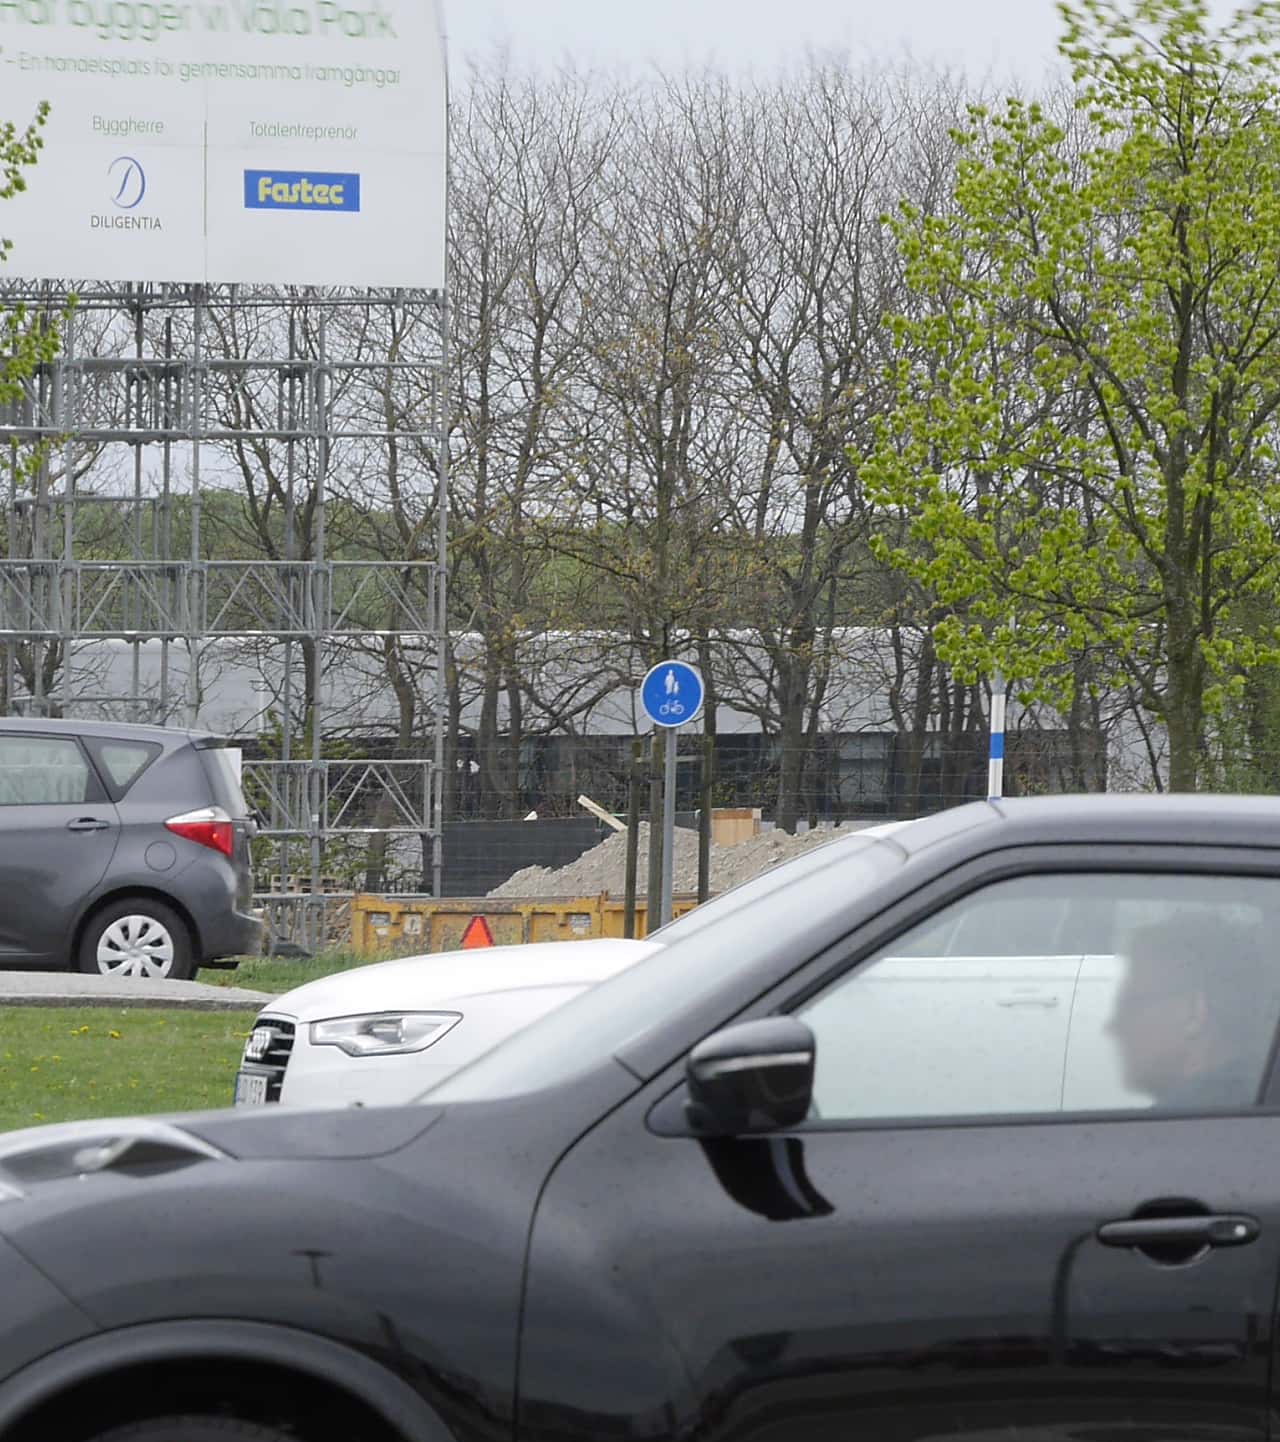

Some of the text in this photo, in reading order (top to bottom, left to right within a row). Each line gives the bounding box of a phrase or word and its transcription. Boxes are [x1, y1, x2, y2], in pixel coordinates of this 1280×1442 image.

[67, 0, 190, 42] bygger
[316, 0, 399, 38] Park
[18, 51, 41, 71] En
[43, 53, 152, 78] handelsplats
[179, 61, 302, 82] gemensamma
[92, 114, 164, 137] Byggherre
[90, 215, 163, 231] DILIGENTIA
